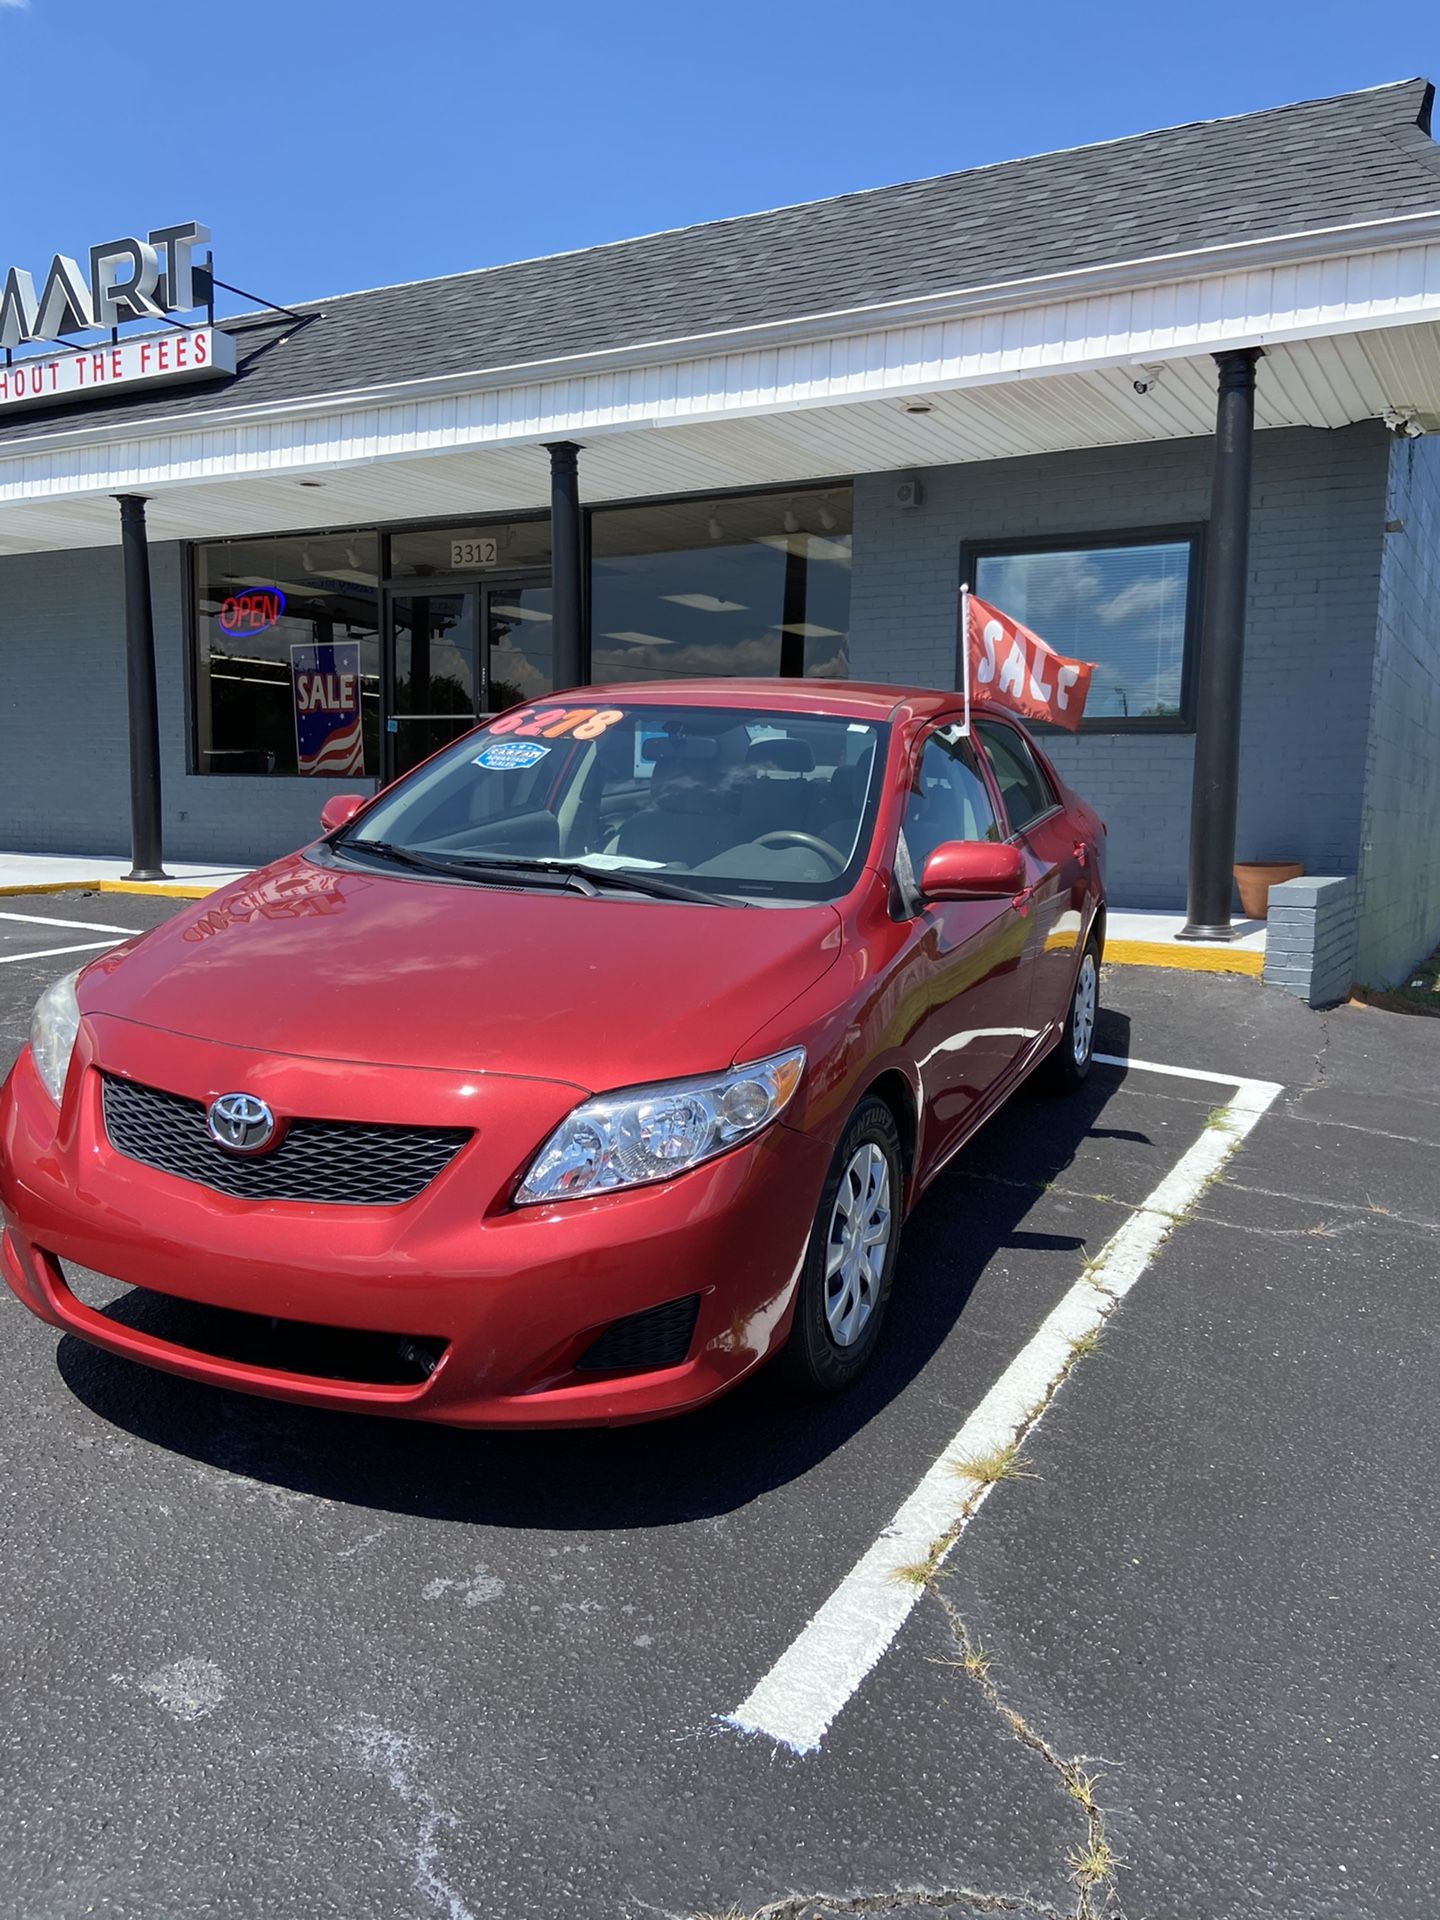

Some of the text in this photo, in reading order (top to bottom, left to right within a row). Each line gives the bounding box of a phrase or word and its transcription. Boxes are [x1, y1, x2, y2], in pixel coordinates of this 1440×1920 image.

[76, 350, 122, 385] THE
[140, 334, 207, 373] FEES
[453, 544, 495, 564] 3312
[221, 595, 278, 628] OPEN
[978, 620, 1080, 710] SALE
[298, 674, 354, 710] SALE
[489, 708, 623, 740] 6278
